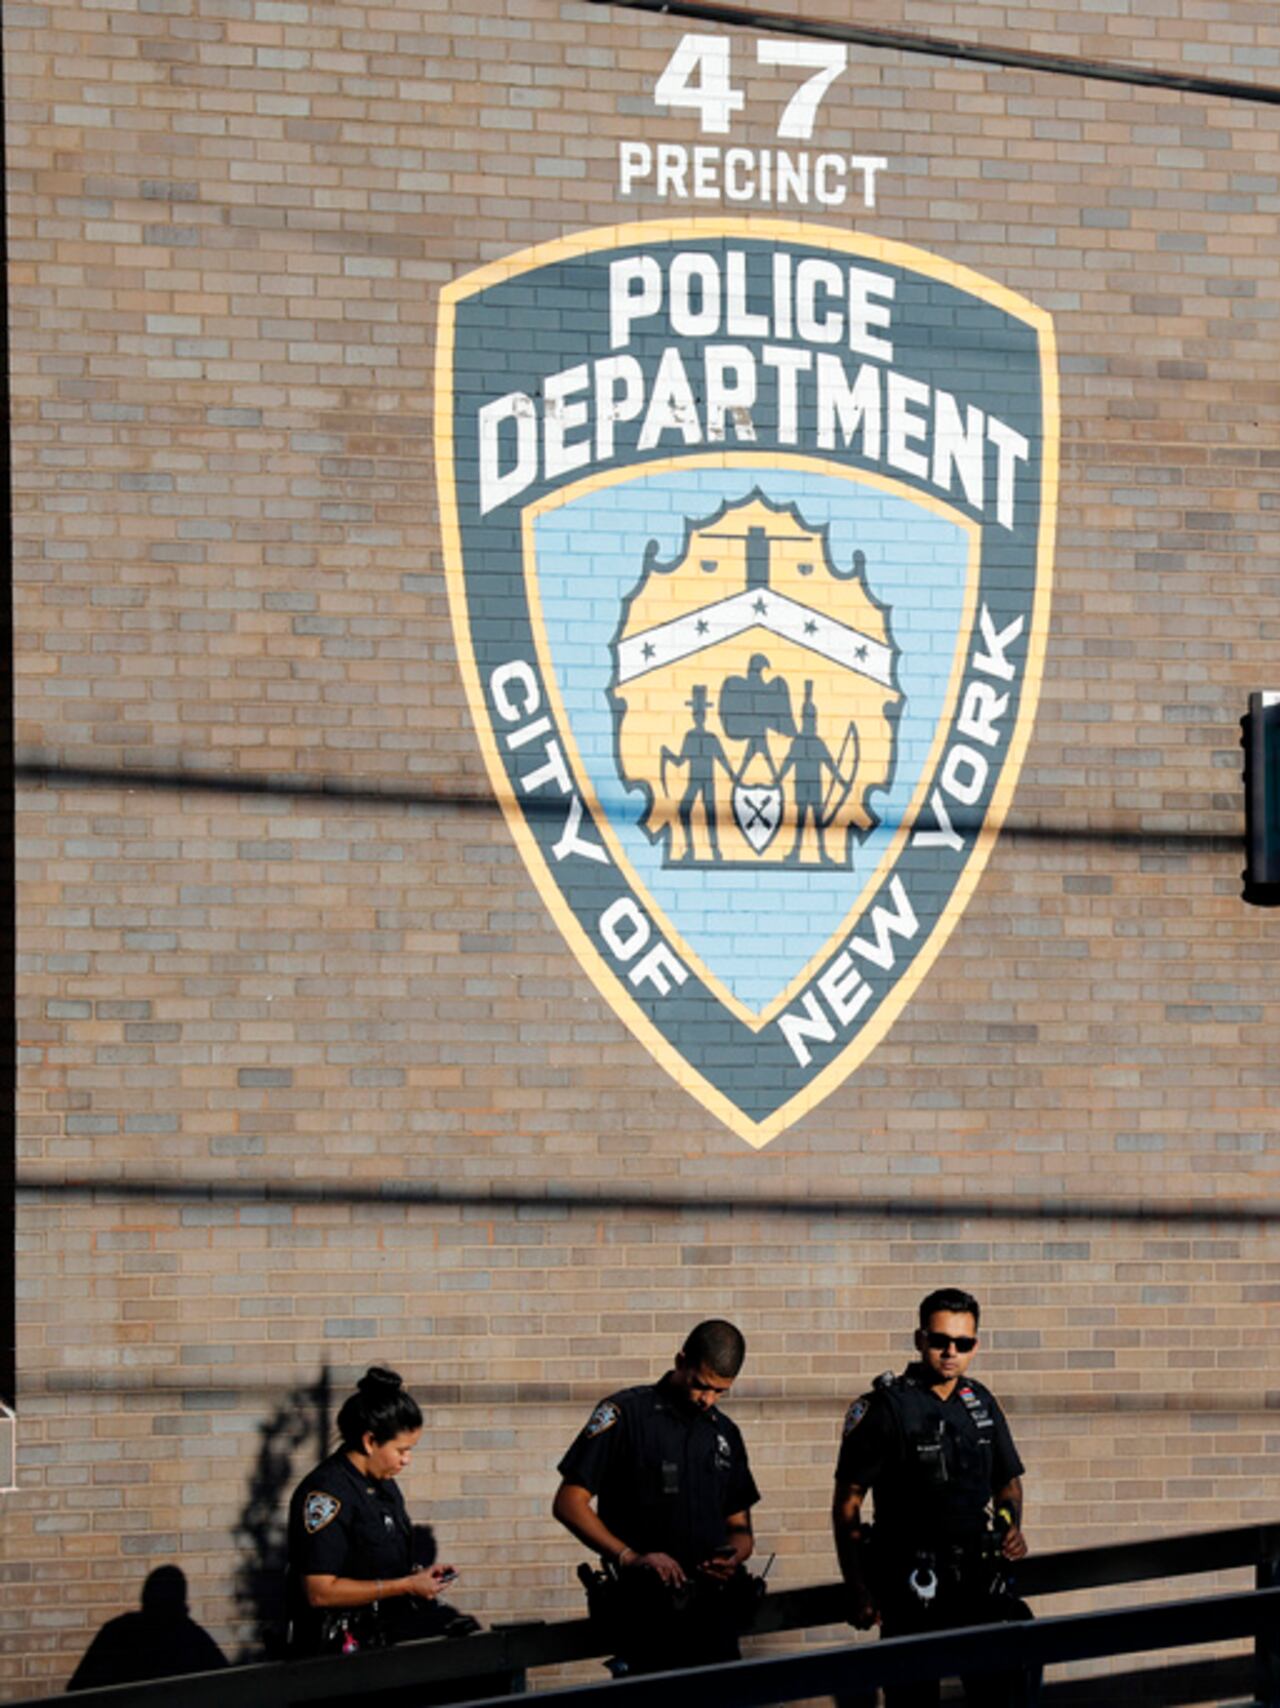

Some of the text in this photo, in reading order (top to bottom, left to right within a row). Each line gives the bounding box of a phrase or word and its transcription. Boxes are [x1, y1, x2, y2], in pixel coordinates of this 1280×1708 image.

[654, 34, 847, 139] 47
[619, 142, 888, 207] PRECINCT
[610, 251, 896, 362] POLICE
[478, 345, 1030, 531] DEPARTMENT
[490, 660, 689, 997] CITY OF
[777, 602, 1024, 1067] NEW YORK
